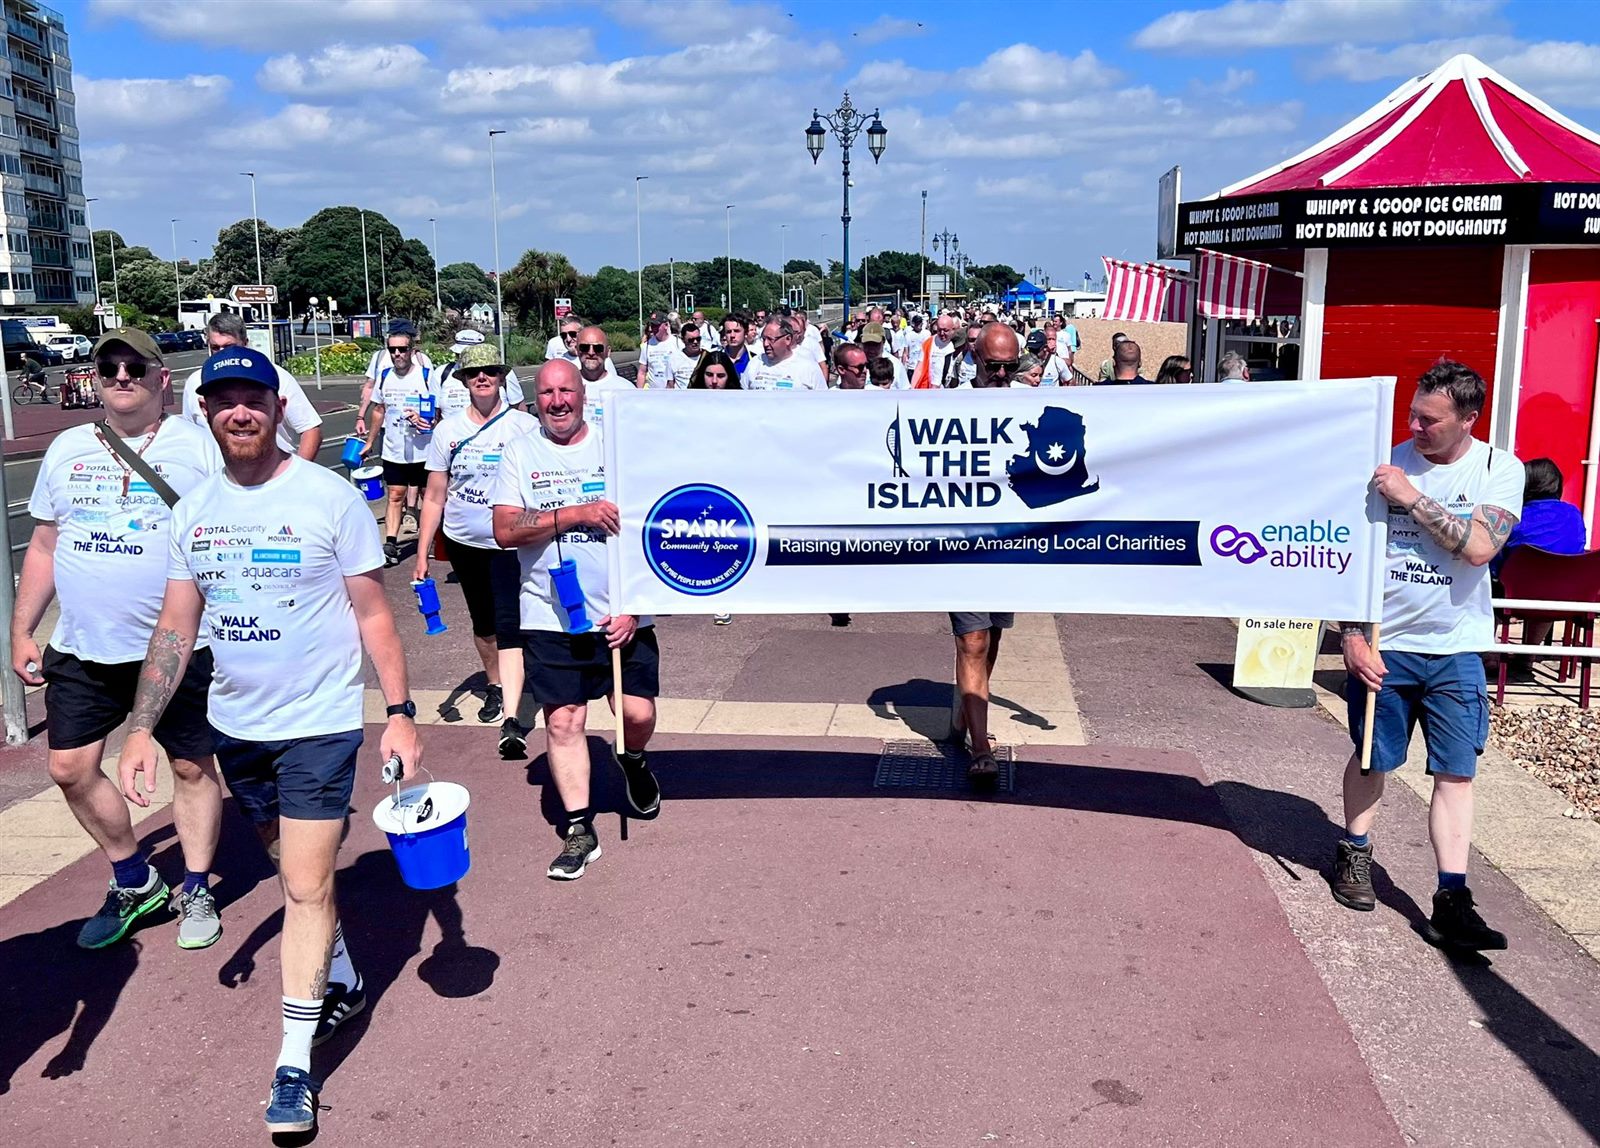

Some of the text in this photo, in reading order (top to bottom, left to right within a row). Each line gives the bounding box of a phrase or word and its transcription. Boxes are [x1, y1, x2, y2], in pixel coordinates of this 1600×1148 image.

[1306, 194, 1503, 215] WHIPPY & SCOOP ICE CREAM
[1553, 192, 1578, 209] HOT
[1189, 202, 1279, 224] WHIPPY & SCOOP ICE CREAM
[1183, 223, 1283, 245] HOT DRINKS & HOT DOUGHNUTS
[1295, 218, 1508, 239] HOT DRINKS & HOT DOUGHNUTS
[213, 358, 240, 370] STANCE
[907, 417, 1014, 445] WALK
[919, 450, 991, 477] THE
[464, 487, 485, 497] WALK
[867, 482, 1002, 509] ISLAND
[72, 497, 101, 505] MTK
[466, 495, 489, 505] ISLAN
[540, 500, 565, 509] MTK
[660, 519, 737, 538] SPARK
[1261, 519, 1351, 543] enable
[1392, 530, 1420, 538] MTK
[73, 541, 144, 555] THE ISLAND
[660, 540, 739, 553] Community Space
[779, 534, 1187, 556] Raising Money for Two Amazing Local Charities
[1269, 544, 1353, 575] ability
[196, 570, 227, 581] MTK
[241, 566, 302, 581] aquacars
[660, 561, 679, 579] HELPING
[676, 574, 696, 586] PEOPLE
[711, 574, 726, 585] BACK
[723, 567, 735, 578] INTO
[732, 559, 743, 570] LIFE
[1405, 562, 1440, 574] WALK
[1390, 570, 1453, 586] THE ISLAND
[220, 615, 260, 628] WALK
[1245, 618, 1314, 629] On sale here
[228, 629, 281, 642] ISLAND
